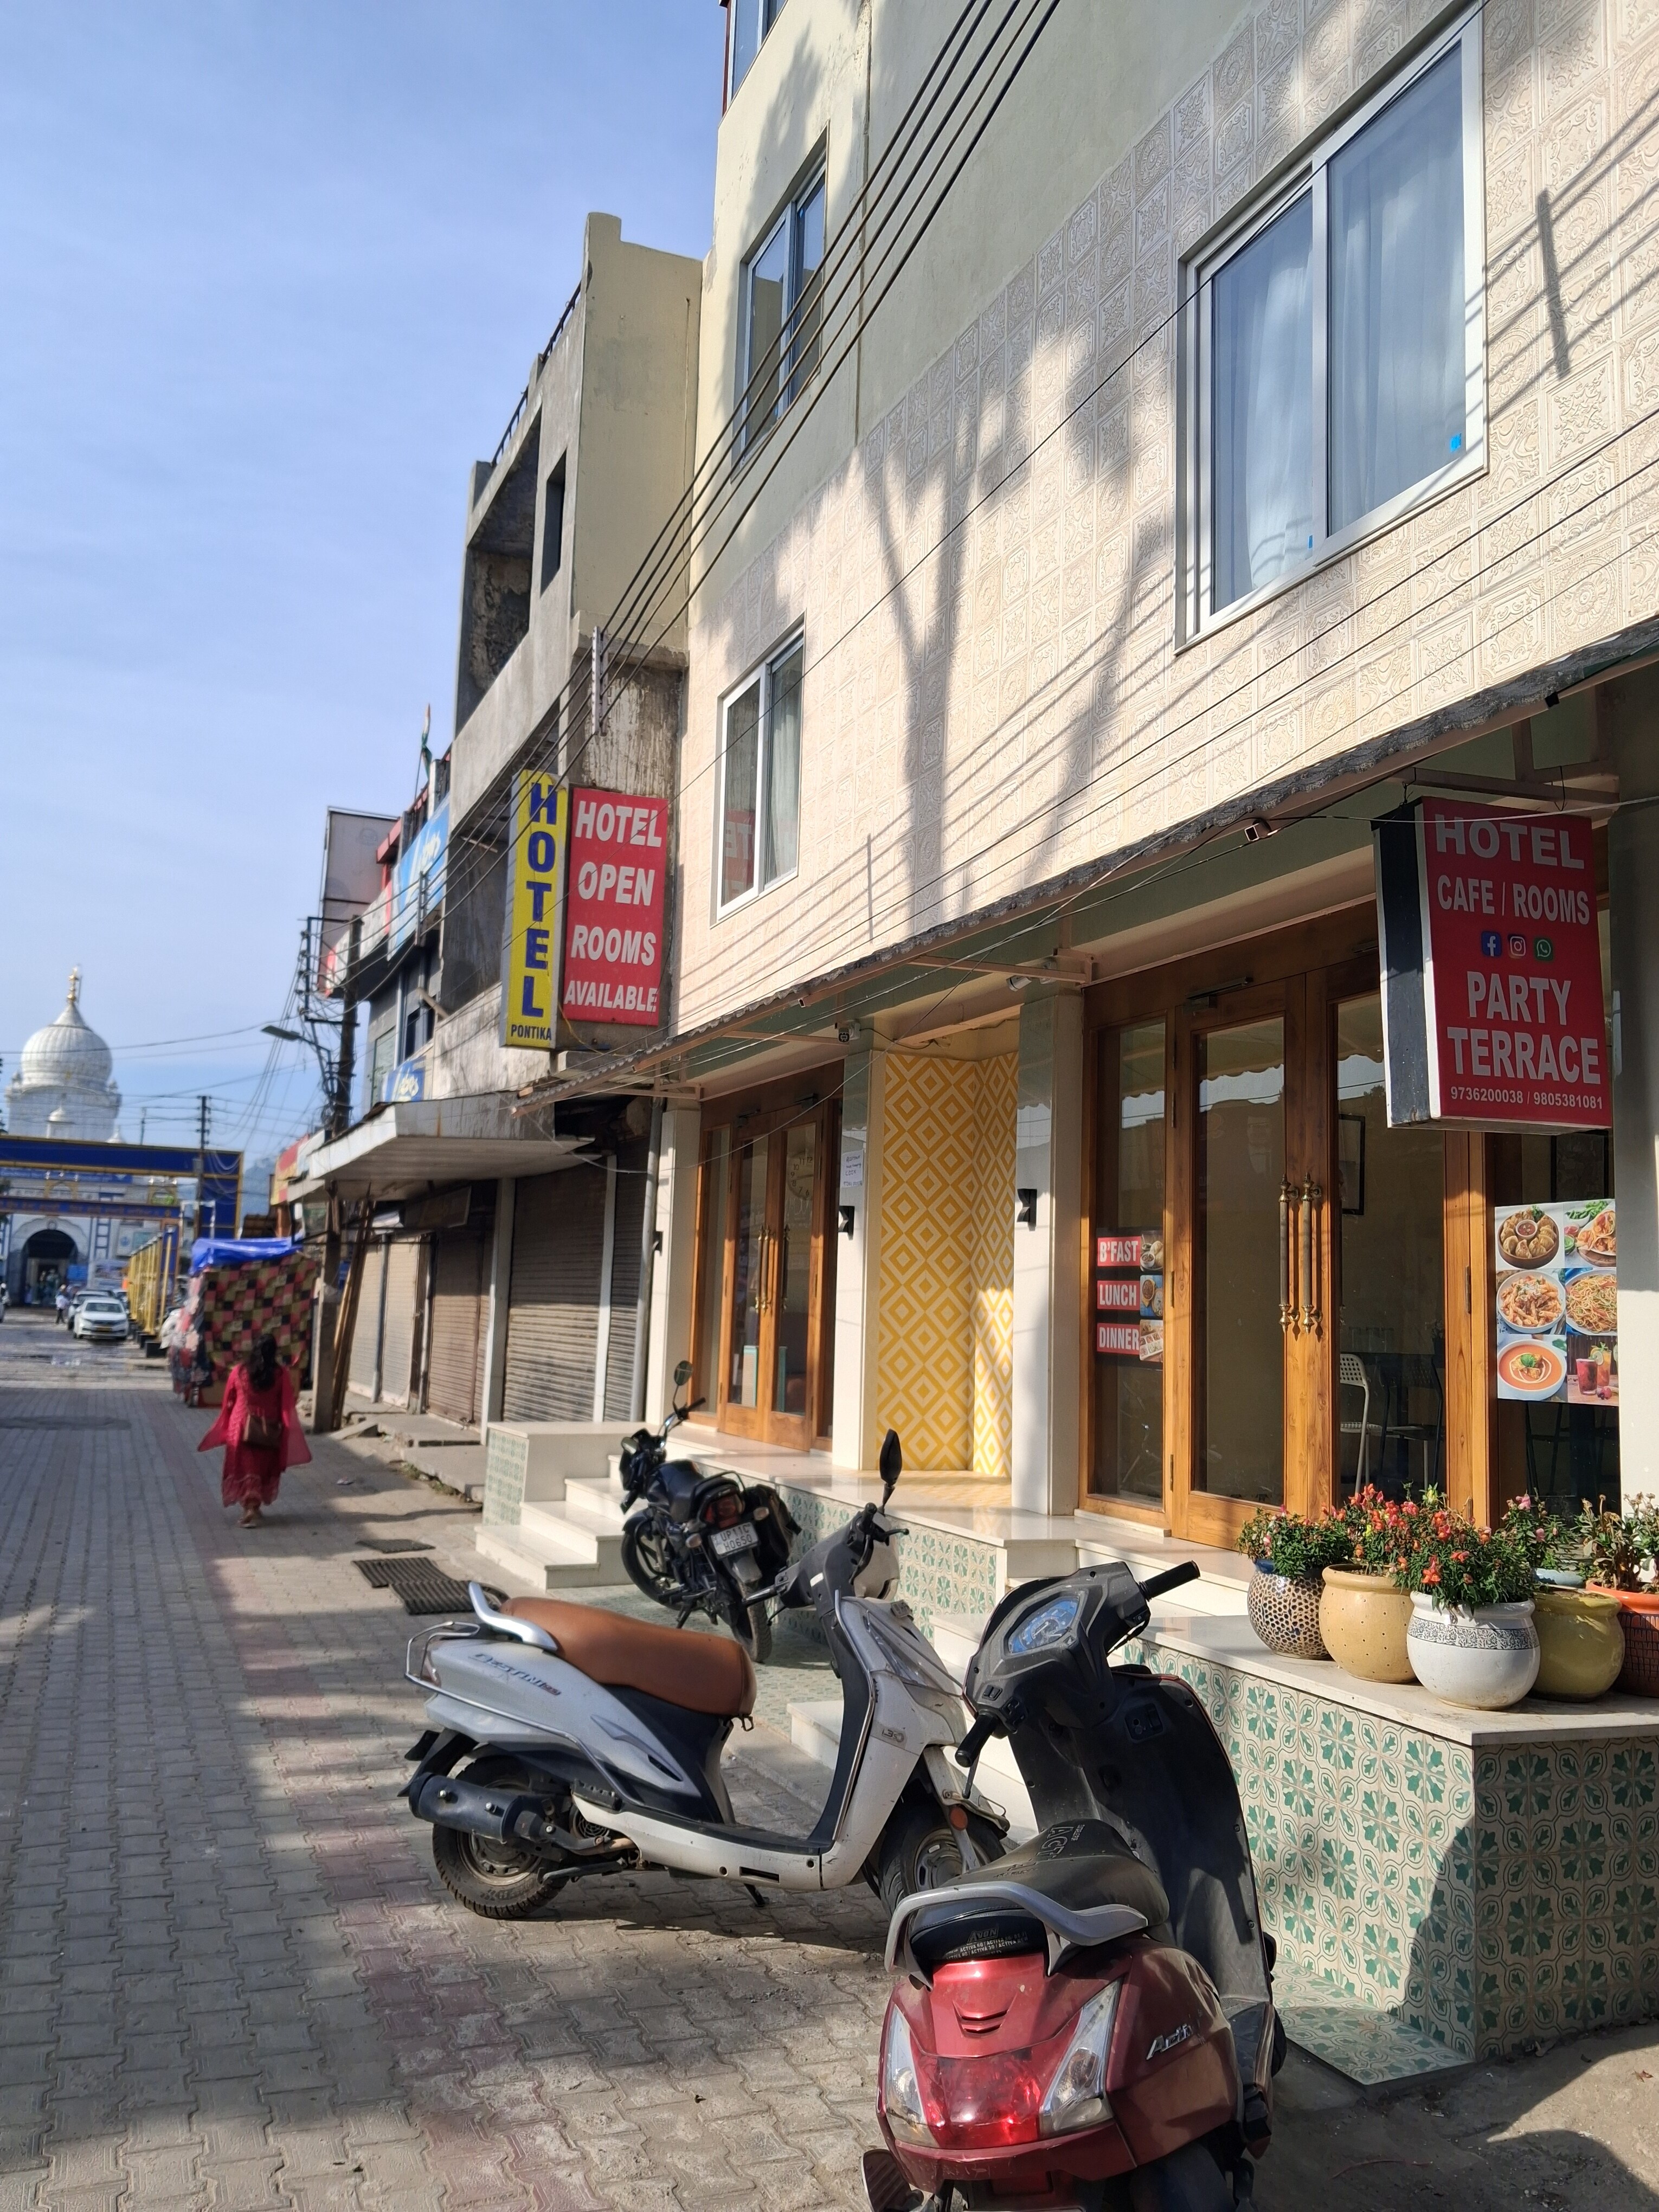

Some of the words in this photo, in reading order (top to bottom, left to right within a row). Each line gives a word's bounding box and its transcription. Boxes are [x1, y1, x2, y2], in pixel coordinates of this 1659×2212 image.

[575, 801, 662, 847] HOTEL
[1435, 814, 1584, 869] HOTEL
[522, 782, 557, 1018] HOTEL
[578, 861, 655, 906] OPEN
[1437, 874, 1495, 914] CAFE
[1513, 883, 1590, 925] ROOMS
[571, 925, 656, 966] ROOMS
[564, 980, 657, 1013] AVAILABLE
[1467, 971, 1571, 1026] PARTY
[511, 1024, 551, 1040] PONTIKA
[1447, 1026, 1601, 1084] TERRACE
[1450, 1086, 1523, 1104] 9736200038
[1533, 1091, 1603, 1109] 9805381081
[1099, 1284, 1137, 1306] LUNCH
[1099, 1327, 1139, 1351] DINNER
